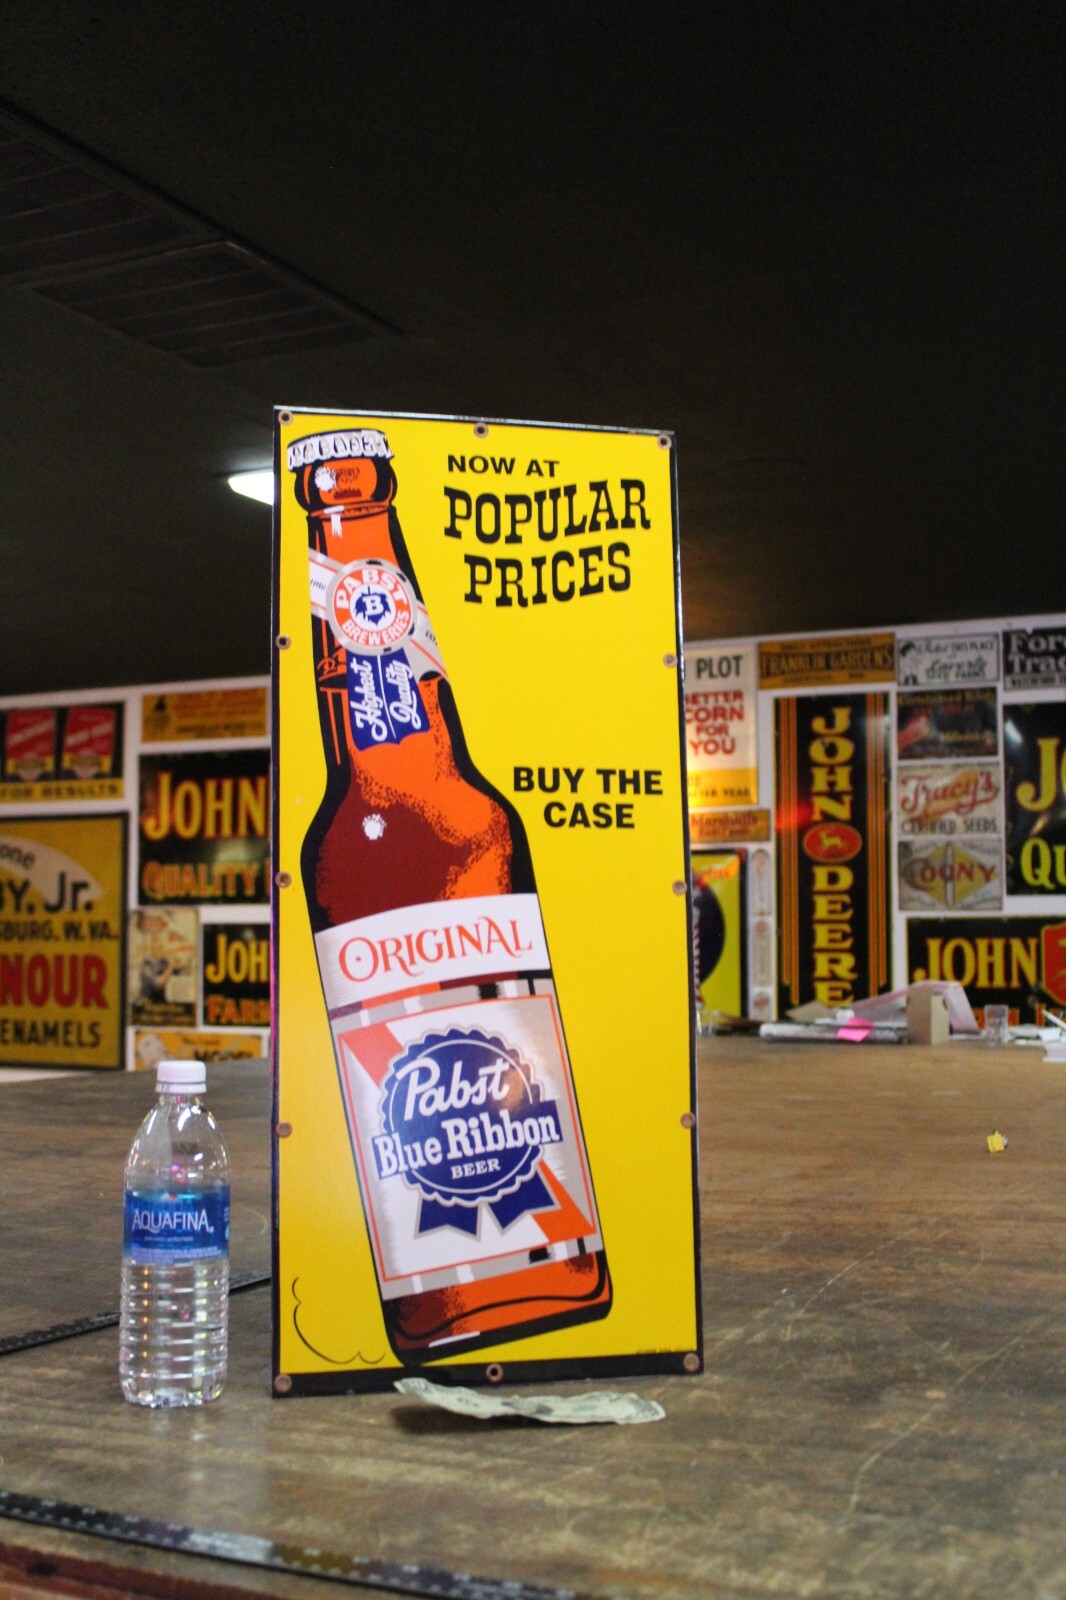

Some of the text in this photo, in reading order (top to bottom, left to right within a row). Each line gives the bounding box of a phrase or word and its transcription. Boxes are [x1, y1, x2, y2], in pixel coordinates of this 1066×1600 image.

[447, 455, 560, 477] NOW AT
[444, 479, 652, 544] POPULAR
[335, 568, 408, 609] PABST
[464, 542, 632, 607] PRICES
[341, 610, 411, 647] BREWERIES
[1011, 633, 1066, 653] For
[697, 656, 742, 678] PLOT
[350, 657, 388, 742] Highest
[385, 659, 422, 730] Quality
[690, 738, 735, 755] YOU
[696, 724, 729, 736] FOR
[513, 766, 584, 793] BUY
[596, 769, 663, 794] THE
[809, 706, 854, 820] JOHN
[143, 772, 267, 839] JOHN
[543, 803, 635, 828] CASE
[0, 871, 93, 914] Y. Jr.
[142, 861, 259, 901] QUALITY
[339, 917, 532, 982] ORIGINAL
[812, 866, 858, 1008] DEERE
[913, 937, 1038, 988] JOHN
[1, 1018, 102, 1048] ENAMELS
[395, 1056, 510, 1121] Pabst
[375, 1109, 561, 1178] Blue Ribbon
[450, 1158, 501, 1180] BEER
[132, 1208, 210, 1234] AQUAFINA
